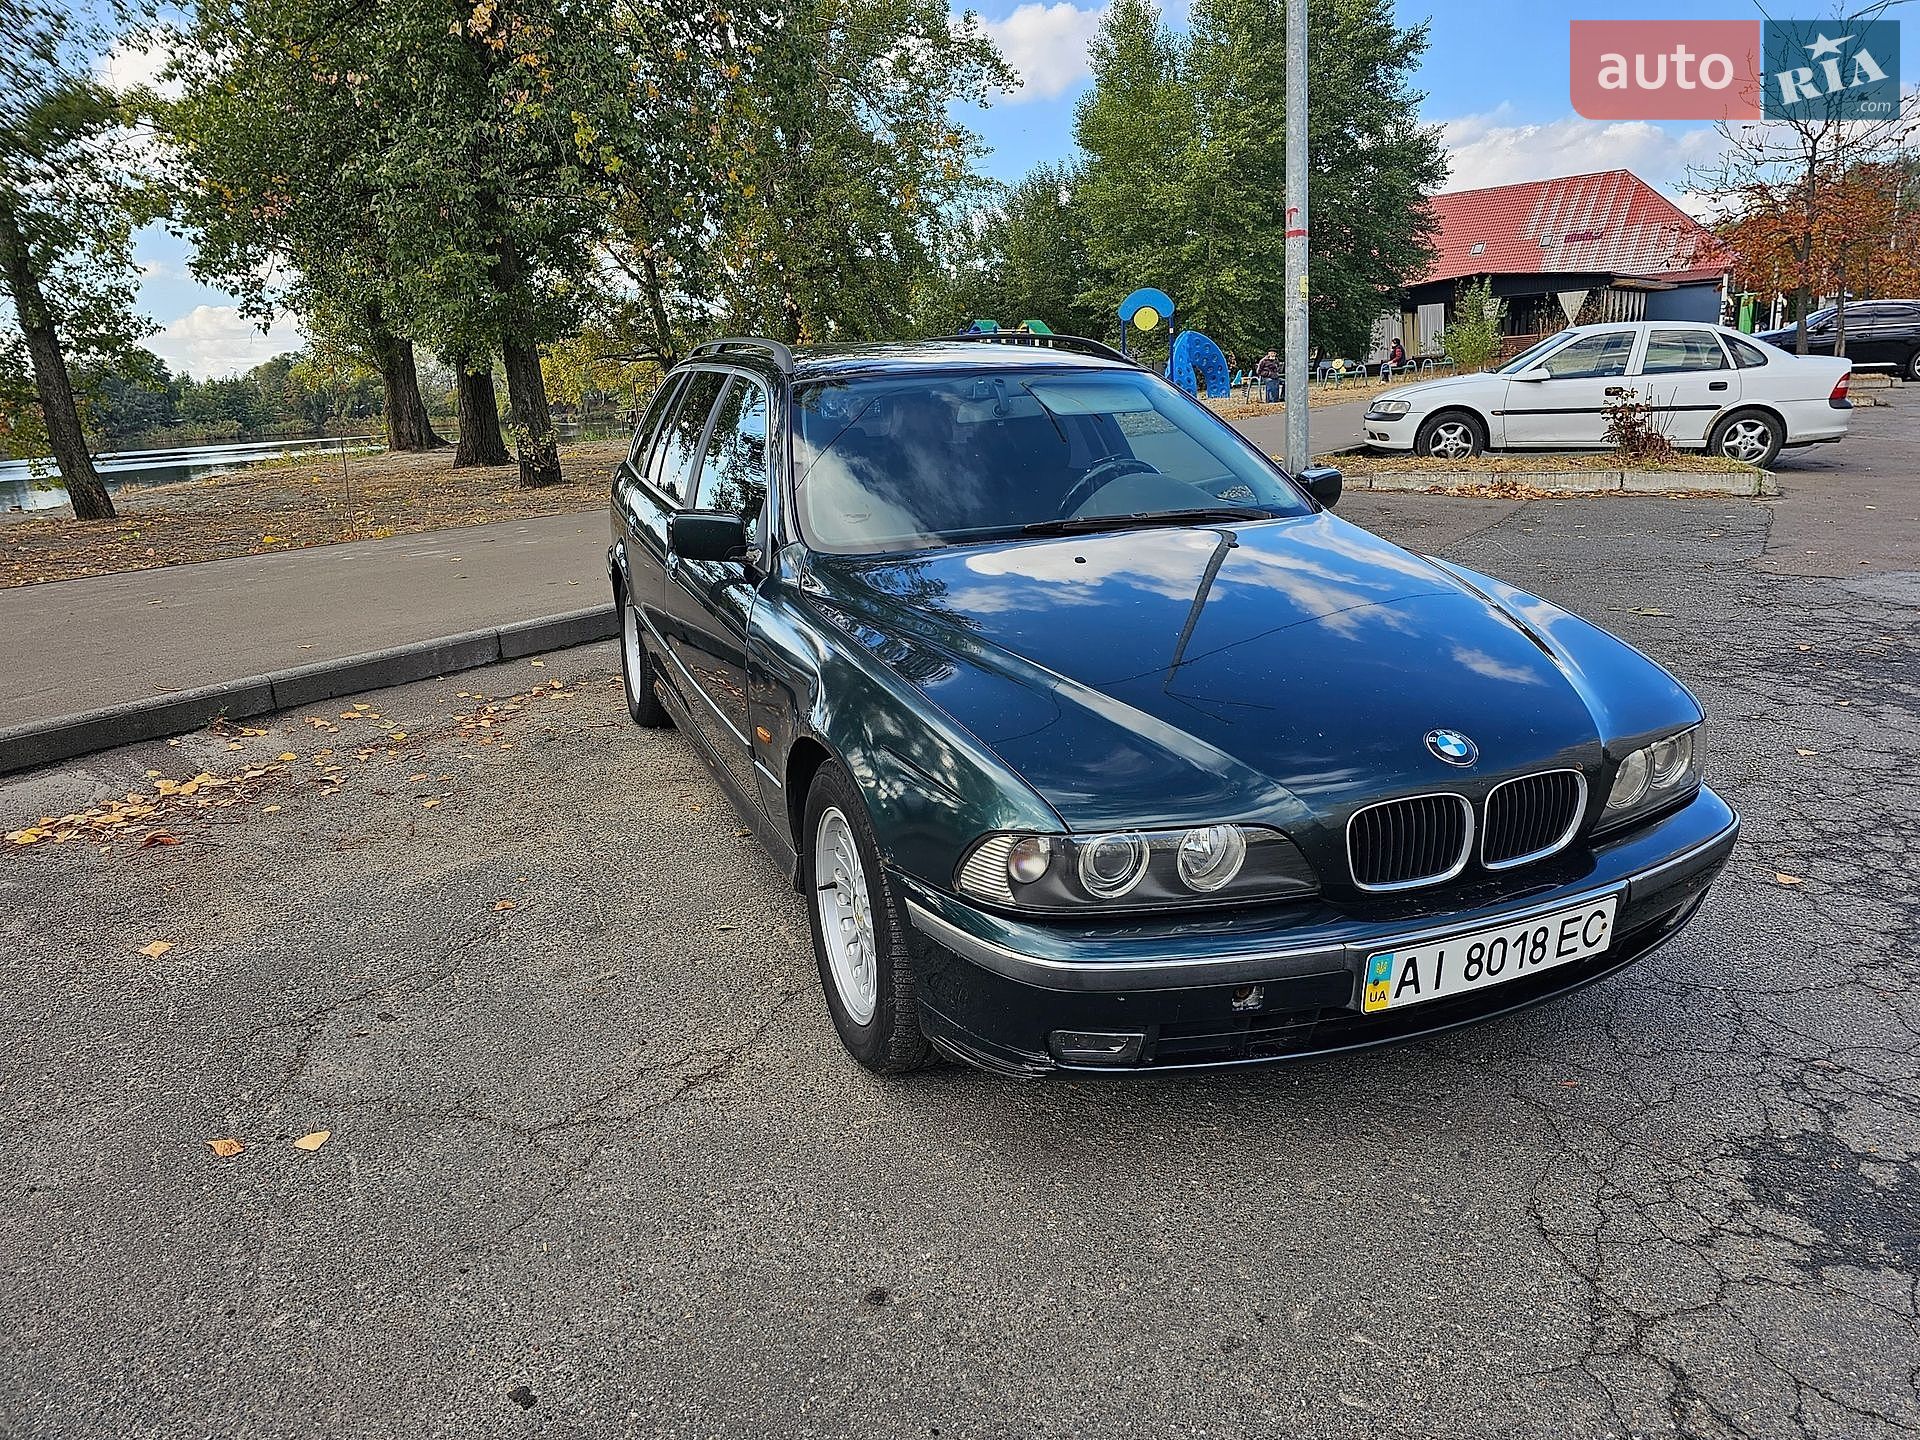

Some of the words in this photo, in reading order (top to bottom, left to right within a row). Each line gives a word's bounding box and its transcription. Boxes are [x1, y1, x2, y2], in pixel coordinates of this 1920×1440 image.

[1463, 925, 1550, 982] 8018
[1555, 909, 1607, 959] EC
[1369, 990, 1387, 1003] UA
